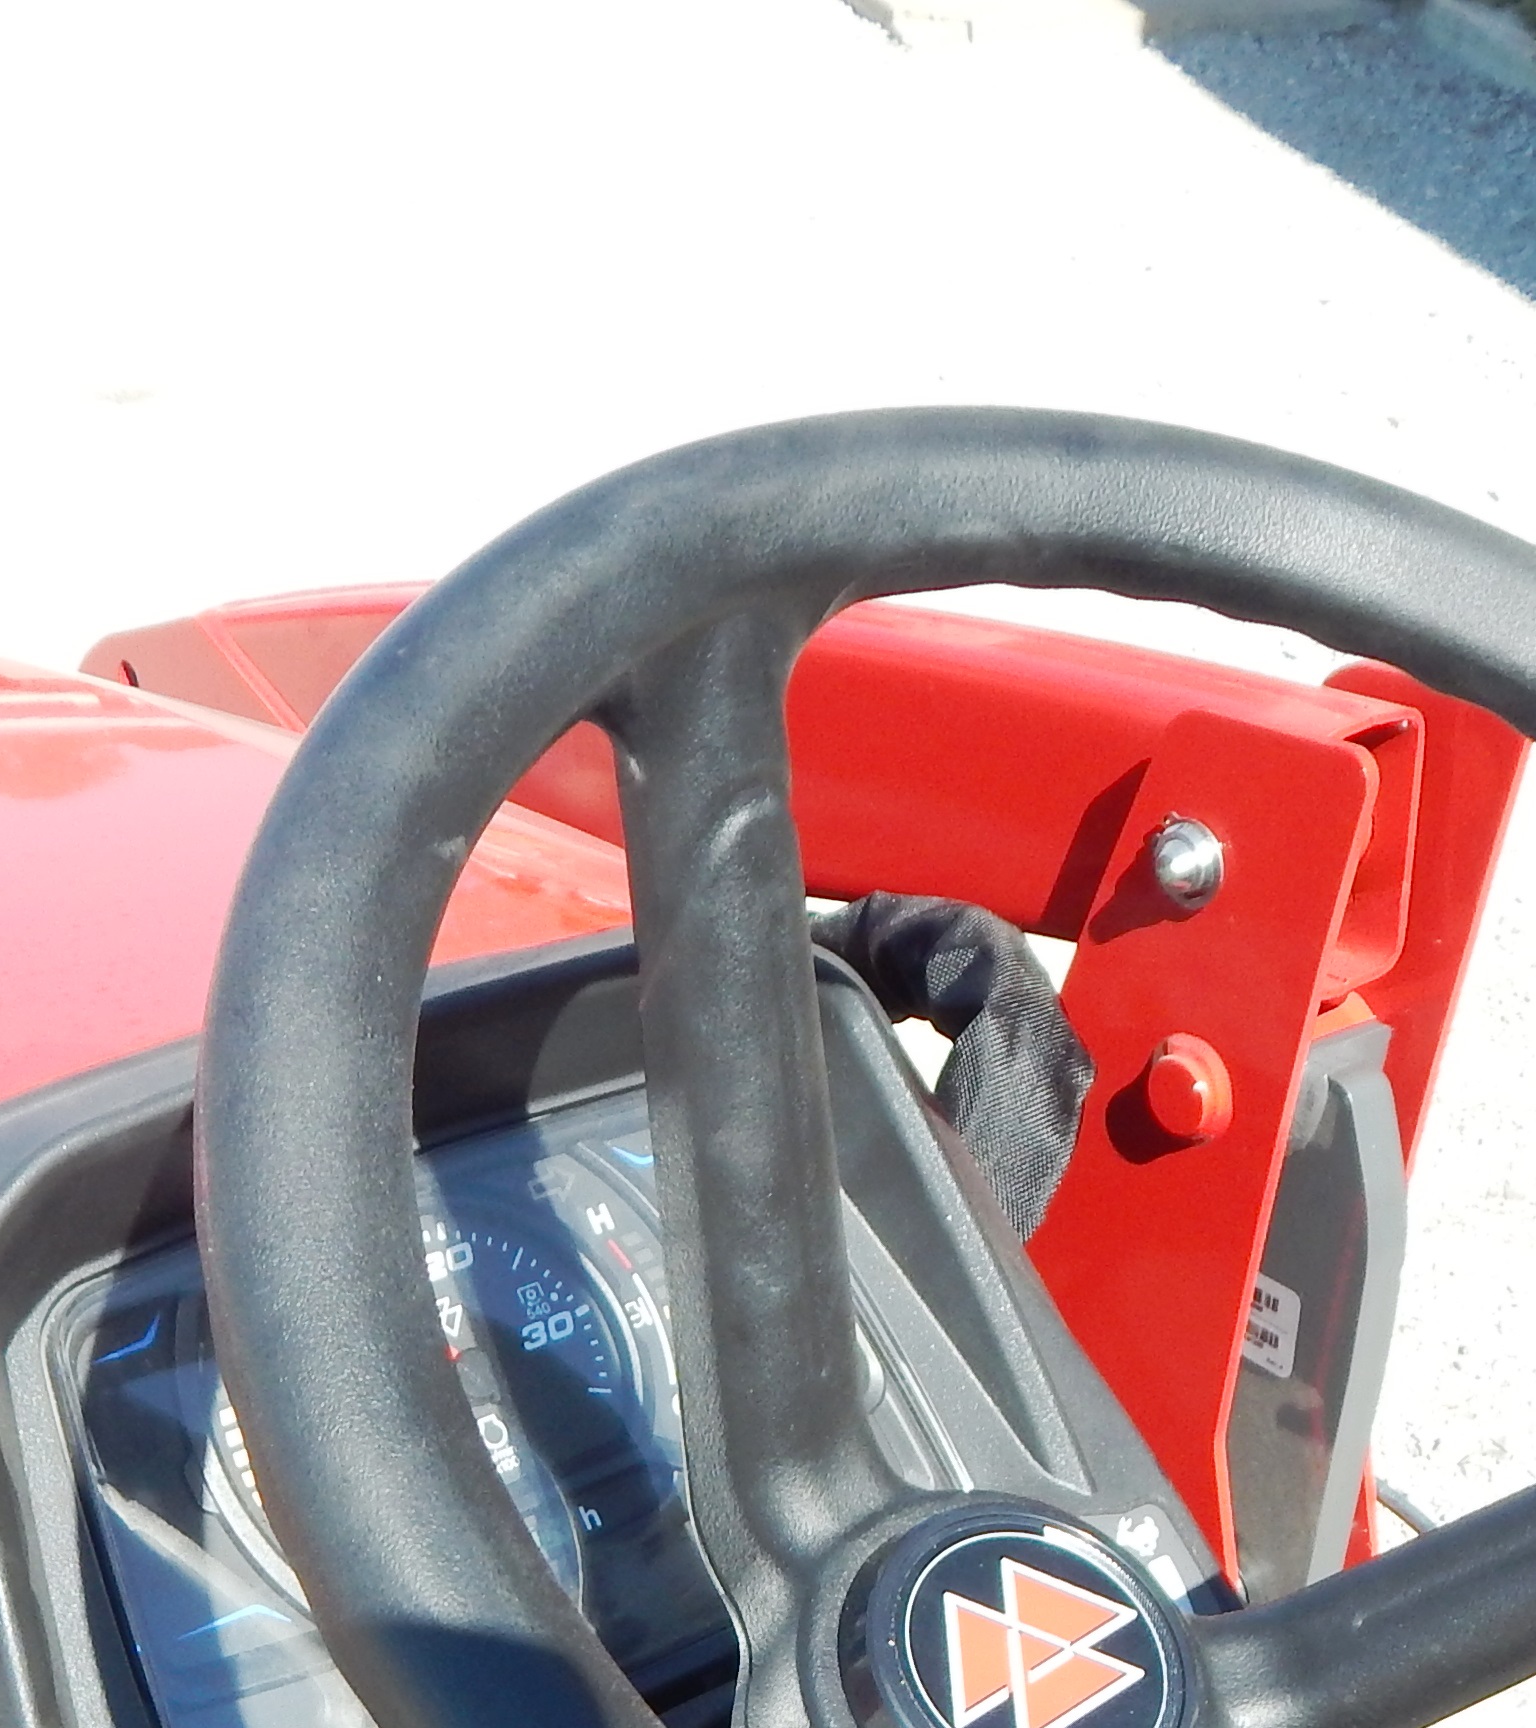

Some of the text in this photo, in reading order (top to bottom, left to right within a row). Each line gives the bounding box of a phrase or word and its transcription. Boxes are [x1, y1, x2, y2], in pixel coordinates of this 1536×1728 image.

[586, 1202, 615, 1235] H
[425, 1241, 474, 1282] 20
[521, 1310, 575, 1351] 30
[578, 1505, 603, 1531] h
